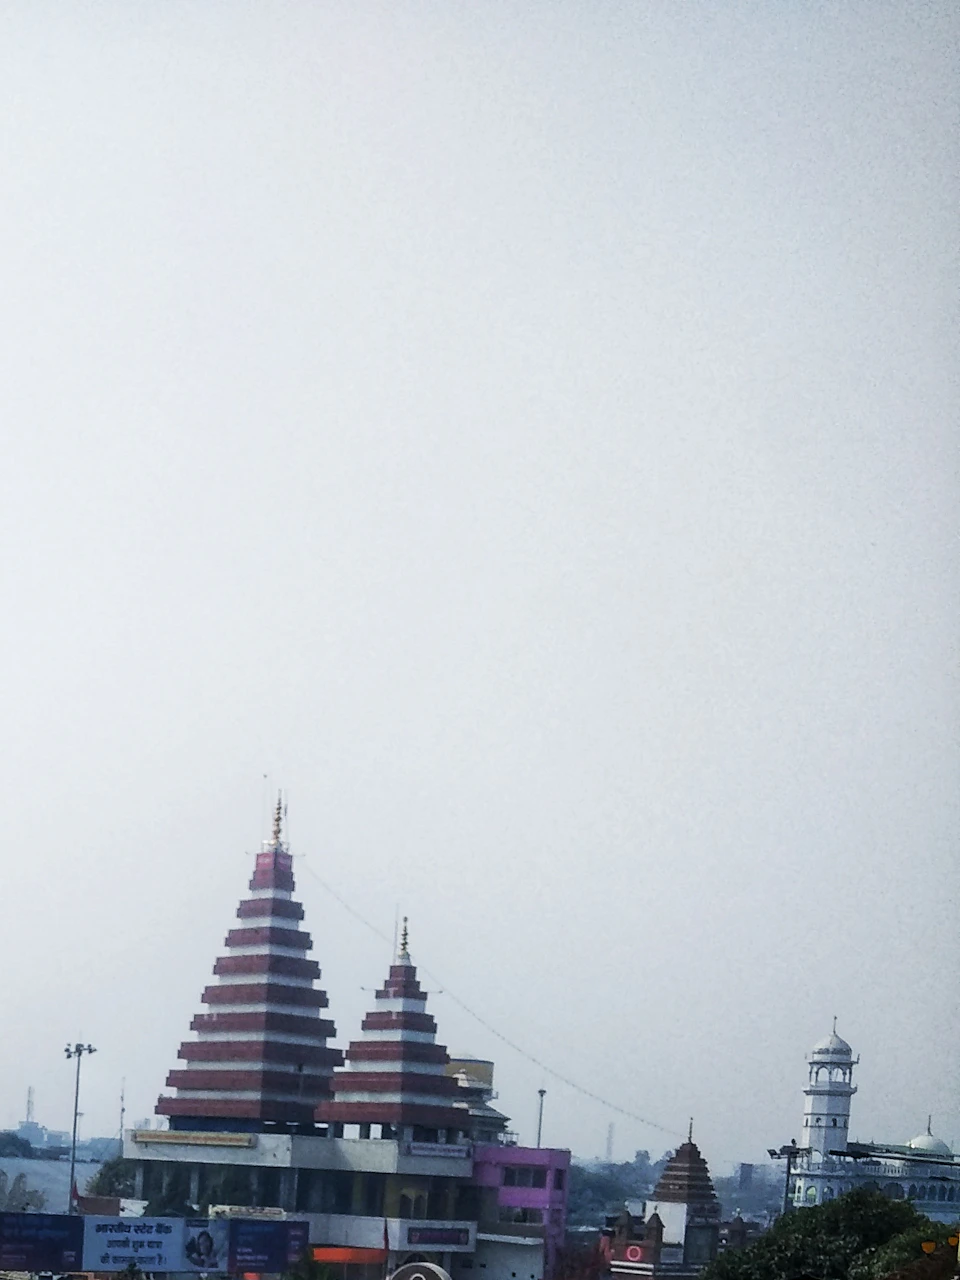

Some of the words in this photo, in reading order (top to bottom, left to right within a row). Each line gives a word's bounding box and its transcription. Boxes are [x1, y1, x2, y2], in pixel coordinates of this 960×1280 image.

[96, 1221, 131, 1233] भारतीय
[134, 1223, 154, 1234] स्टेट
[155, 1222, 172, 1234] बैंक
